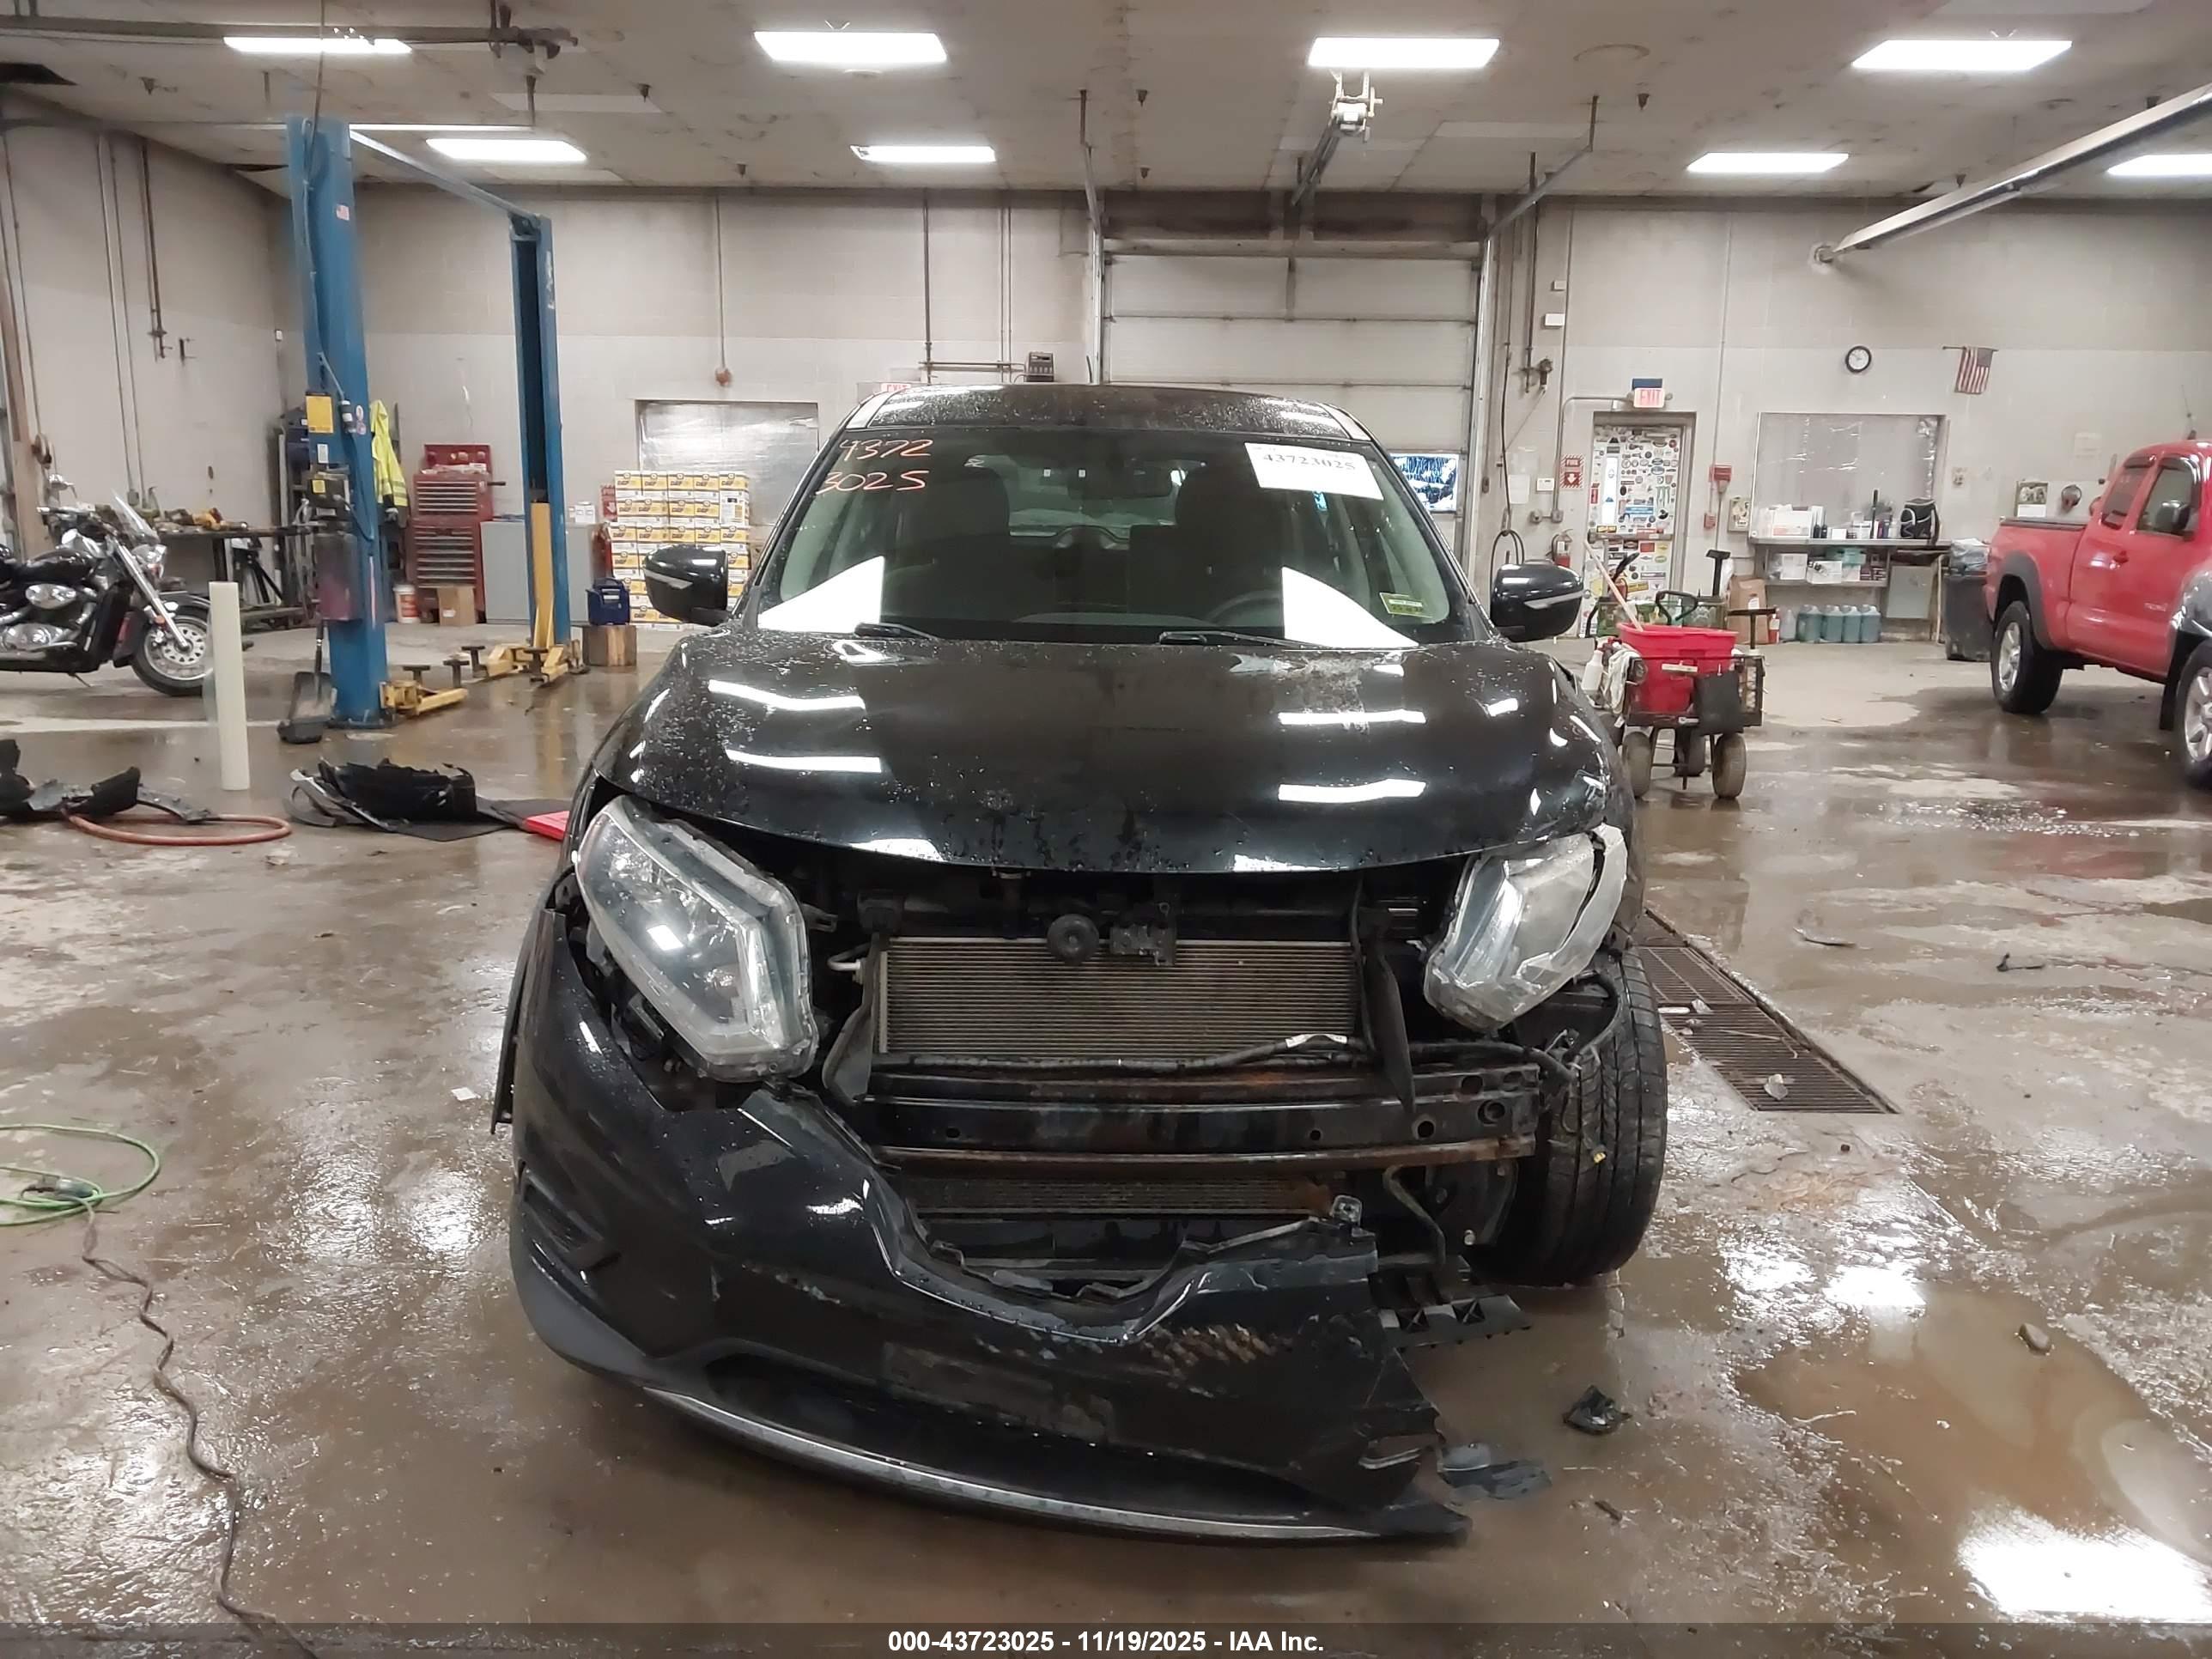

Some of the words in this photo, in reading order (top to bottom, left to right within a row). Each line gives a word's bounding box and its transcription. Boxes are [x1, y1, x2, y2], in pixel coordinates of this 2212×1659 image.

[1640, 389, 1662, 406] EXIT
[839, 439, 934, 461] 4372
[1263, 453, 1357, 471] 43723025
